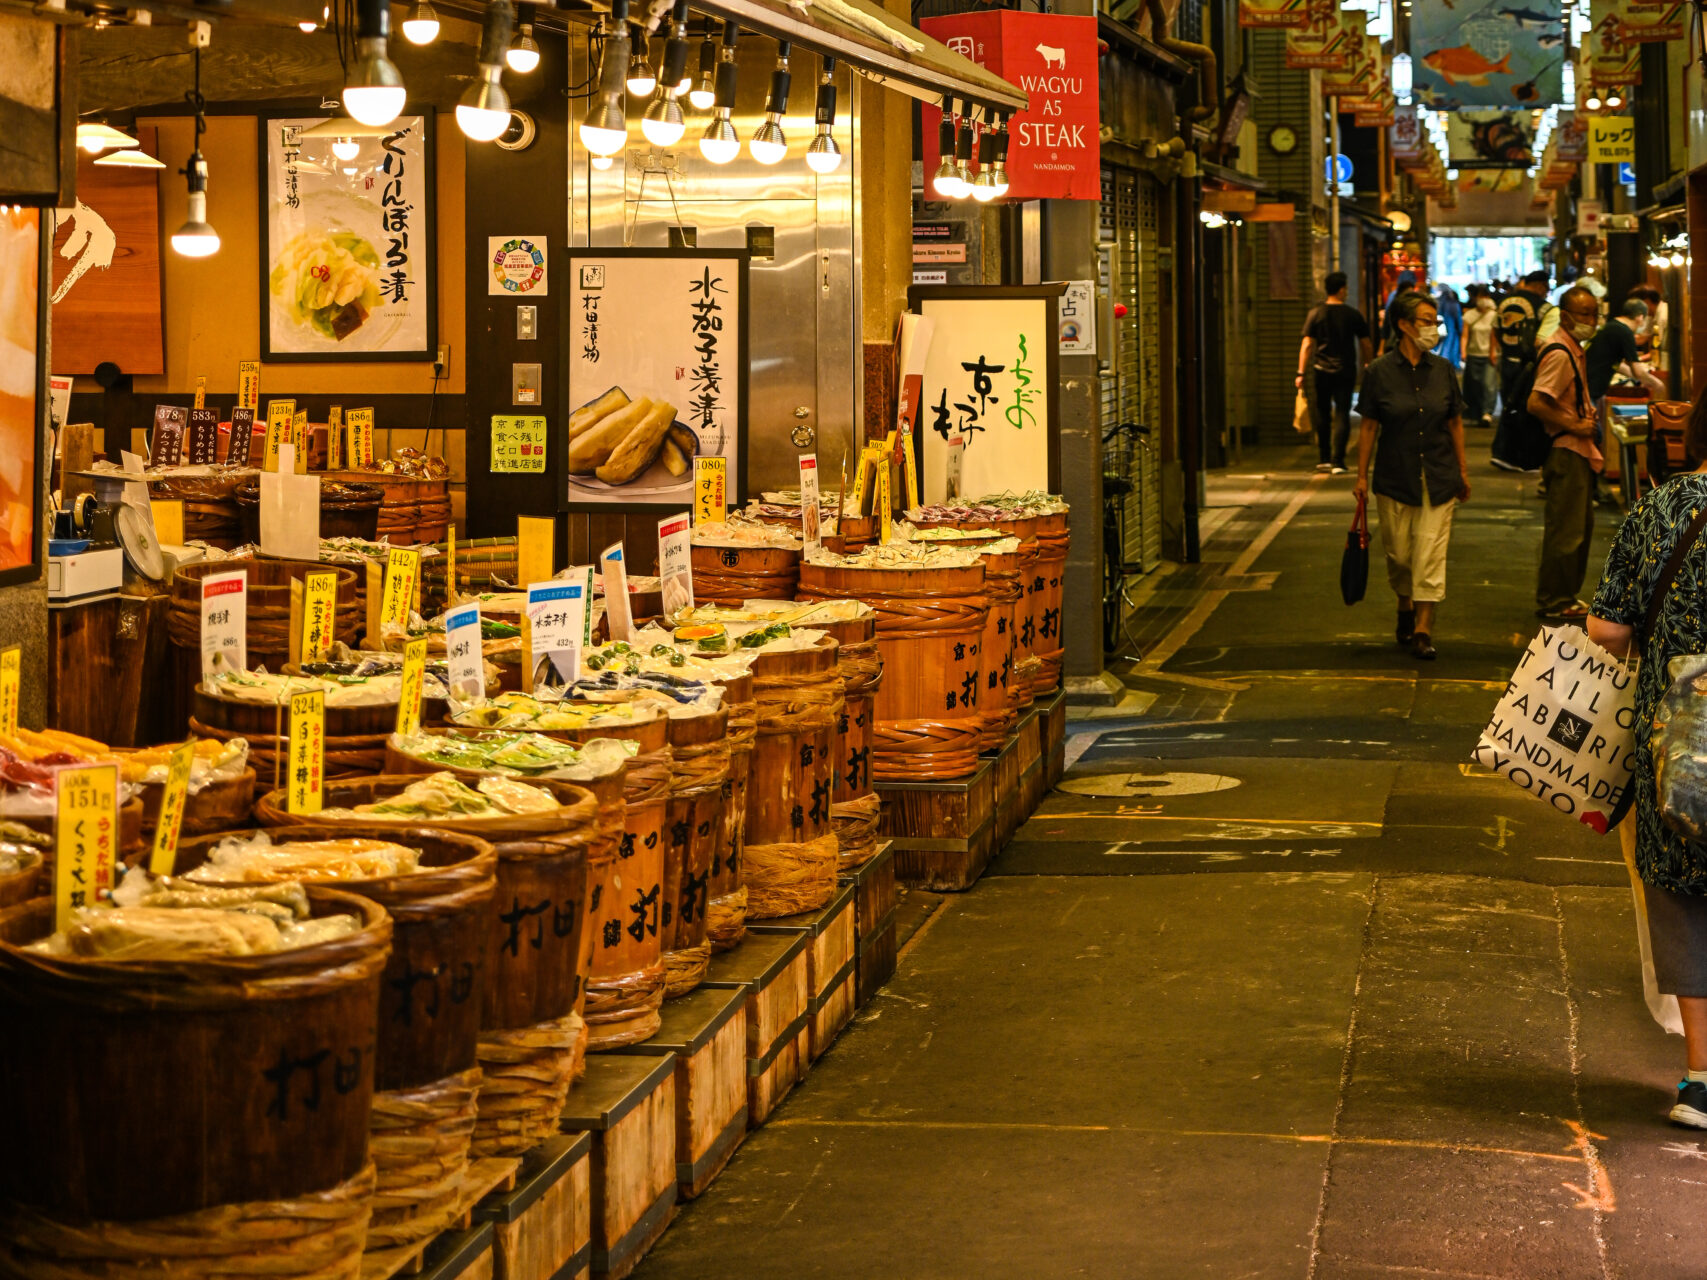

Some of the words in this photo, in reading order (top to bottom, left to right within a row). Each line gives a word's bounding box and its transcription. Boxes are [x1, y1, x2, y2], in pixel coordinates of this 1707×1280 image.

[1020, 75, 1083, 95] WAGYU
[1042, 100, 1062, 116] A5
[1019, 122, 1086, 148] STEAK
[1034, 163, 1076, 171] NANDAIMON
[582, 293, 602, 364] 打田漬物
[689, 265, 729, 430] 水茄子浅漬
[192, 410, 216, 421] 583円
[496, 419, 543, 430] 京都市
[496, 432, 543, 442] 食べ残し
[496, 445, 517, 455] ゼロ
[494, 458, 543, 469] 推進店舗
[702, 478, 714, 520] すぐき
[309, 577, 335, 594] 486円
[321, 600, 333, 651] うちだ特
[1484, 712, 1627, 808] HANDMADE
[1473, 744, 1577, 816] KYOTO
